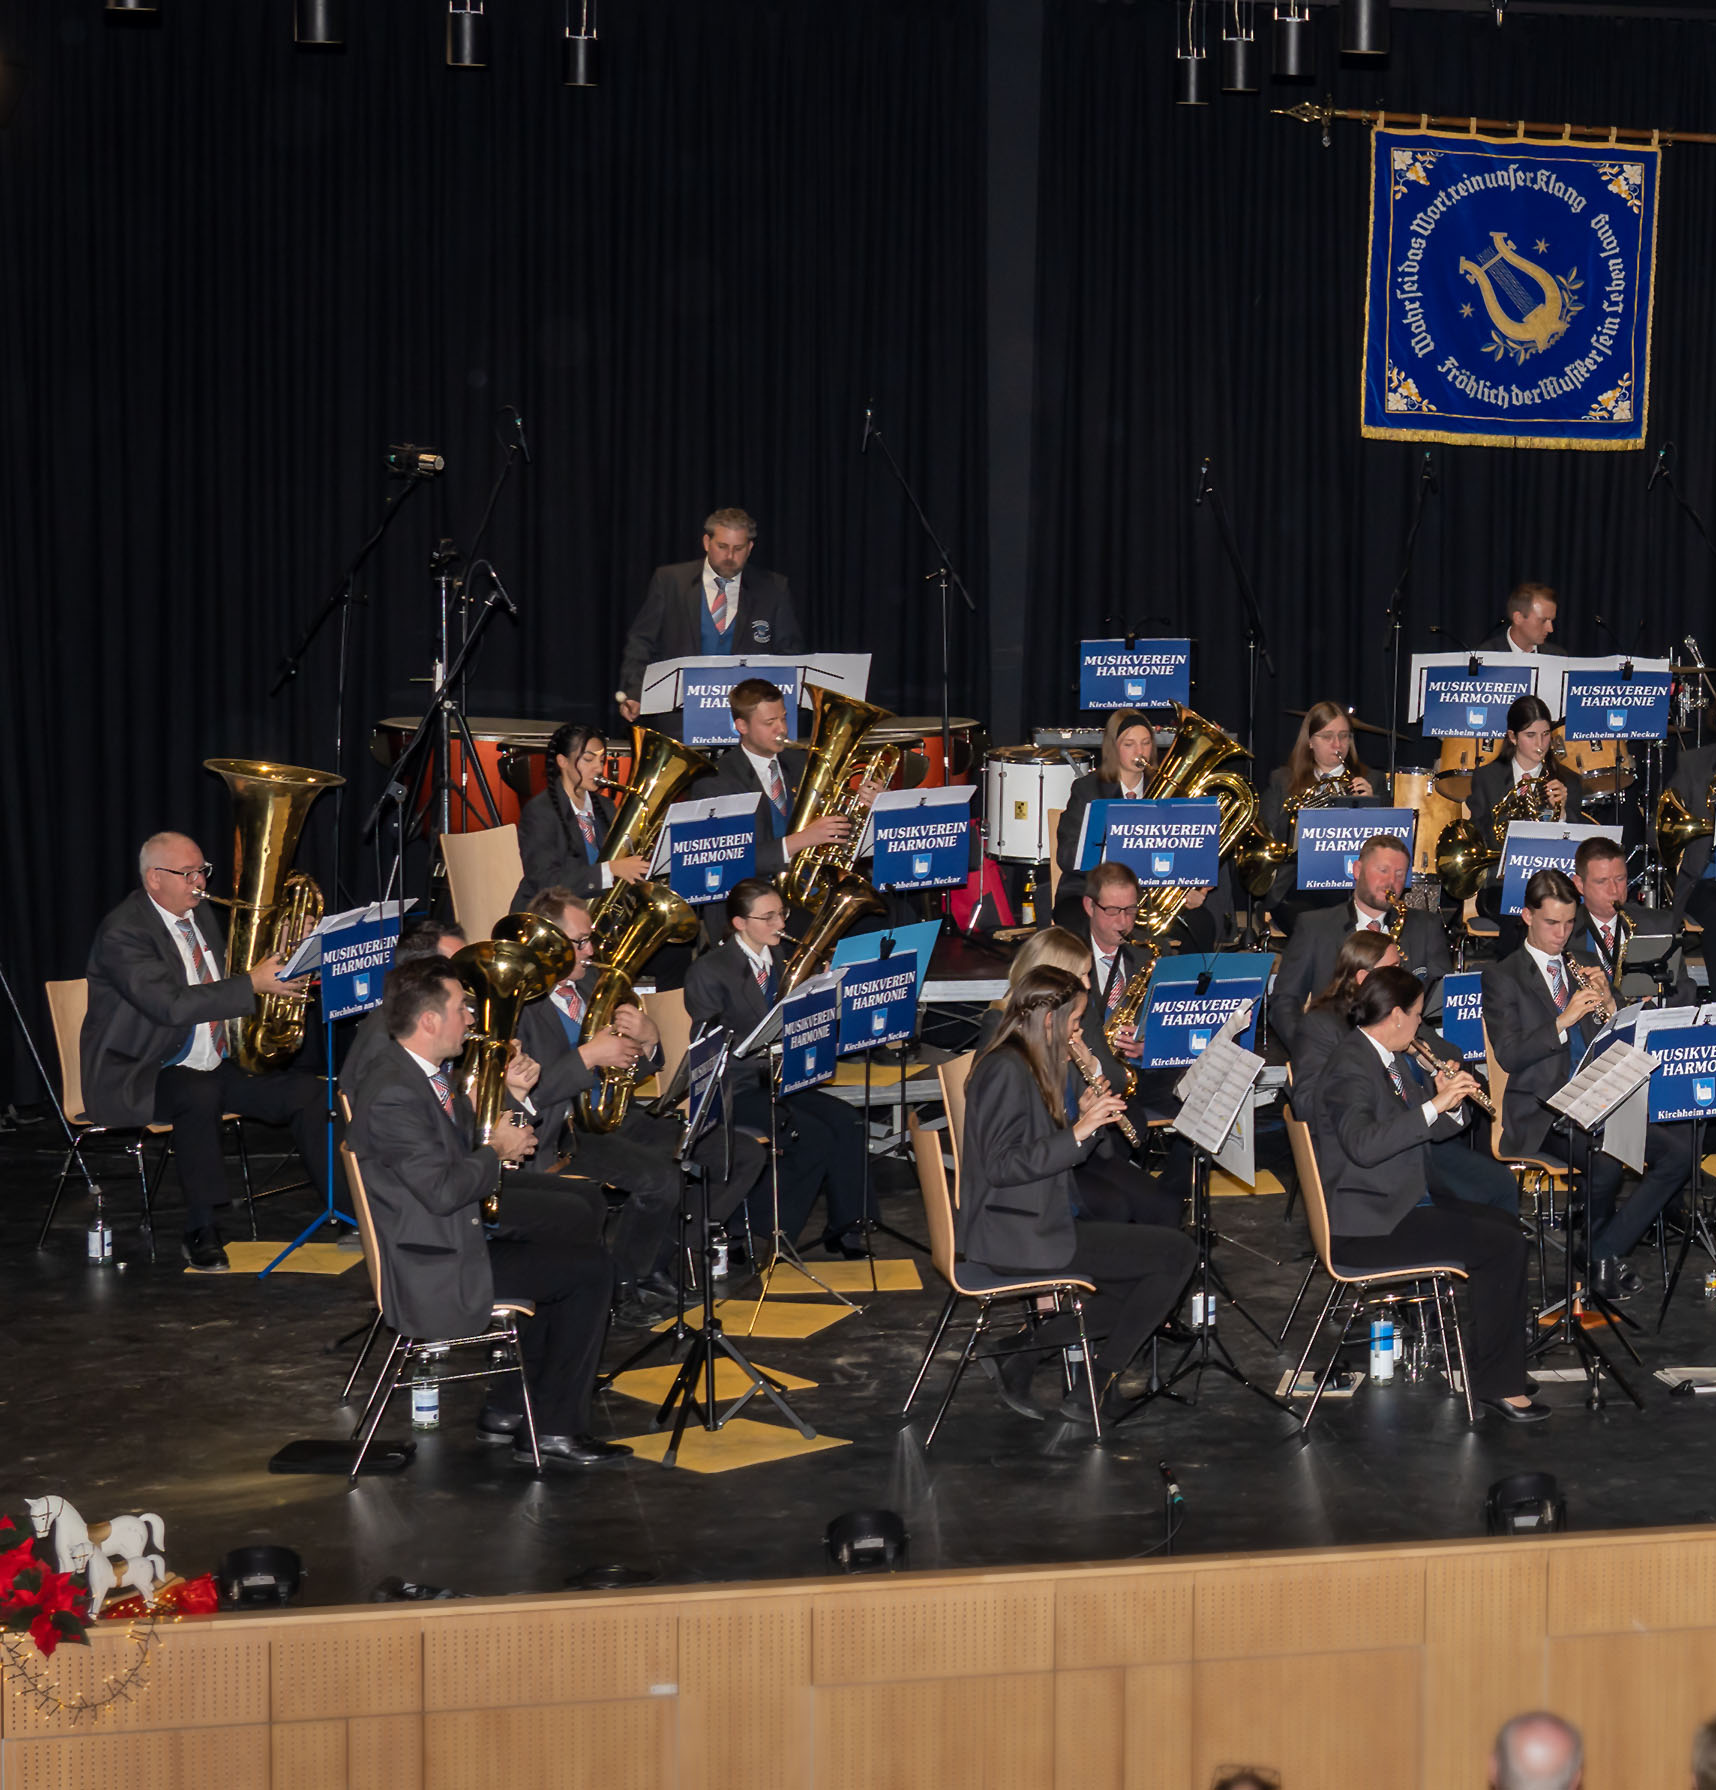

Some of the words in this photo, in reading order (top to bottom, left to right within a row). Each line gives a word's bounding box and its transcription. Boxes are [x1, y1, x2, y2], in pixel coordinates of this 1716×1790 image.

[1084, 655, 1188, 666] MUSIKVEREIN
[1096, 666, 1175, 676] HARMONIE
[1428, 681, 1528, 693] MUSIKVEREIN
[1570, 685, 1668, 696] MUSIKVEREIN
[1089, 700, 1133, 708] Kirchheim
[1439, 693, 1516, 704] HARMONIE
[1581, 697, 1655, 707] HARMONIE
[1431, 728, 1474, 736] Kirchheim
[876, 822, 968, 841] MUSIKVEREIN
[1110, 824, 1218, 836] MUSIKVEREIN
[673, 832, 753, 853] MUSIKVEREIN
[887, 836, 957, 853] HARMONIE
[1122, 837, 1205, 849] HARMONIE
[682, 847, 745, 866] HARMONIE
[934, 876, 961, 885] Neckar
[1177, 877, 1210, 885] Neckar
[1306, 880, 1353, 888] Kirchheim
[323, 935, 400, 965] MUSIKVEREIN
[843, 971, 916, 998] MUSIKVEREIN
[852, 987, 908, 1011] HARMONIE
[1151, 998, 1243, 1013] MUSIKVERE
[784, 1007, 836, 1037] MUSIKVEREIN
[790, 1024, 830, 1050] HARMONIE
[1658, 1108, 1704, 1120] Kirchheim
